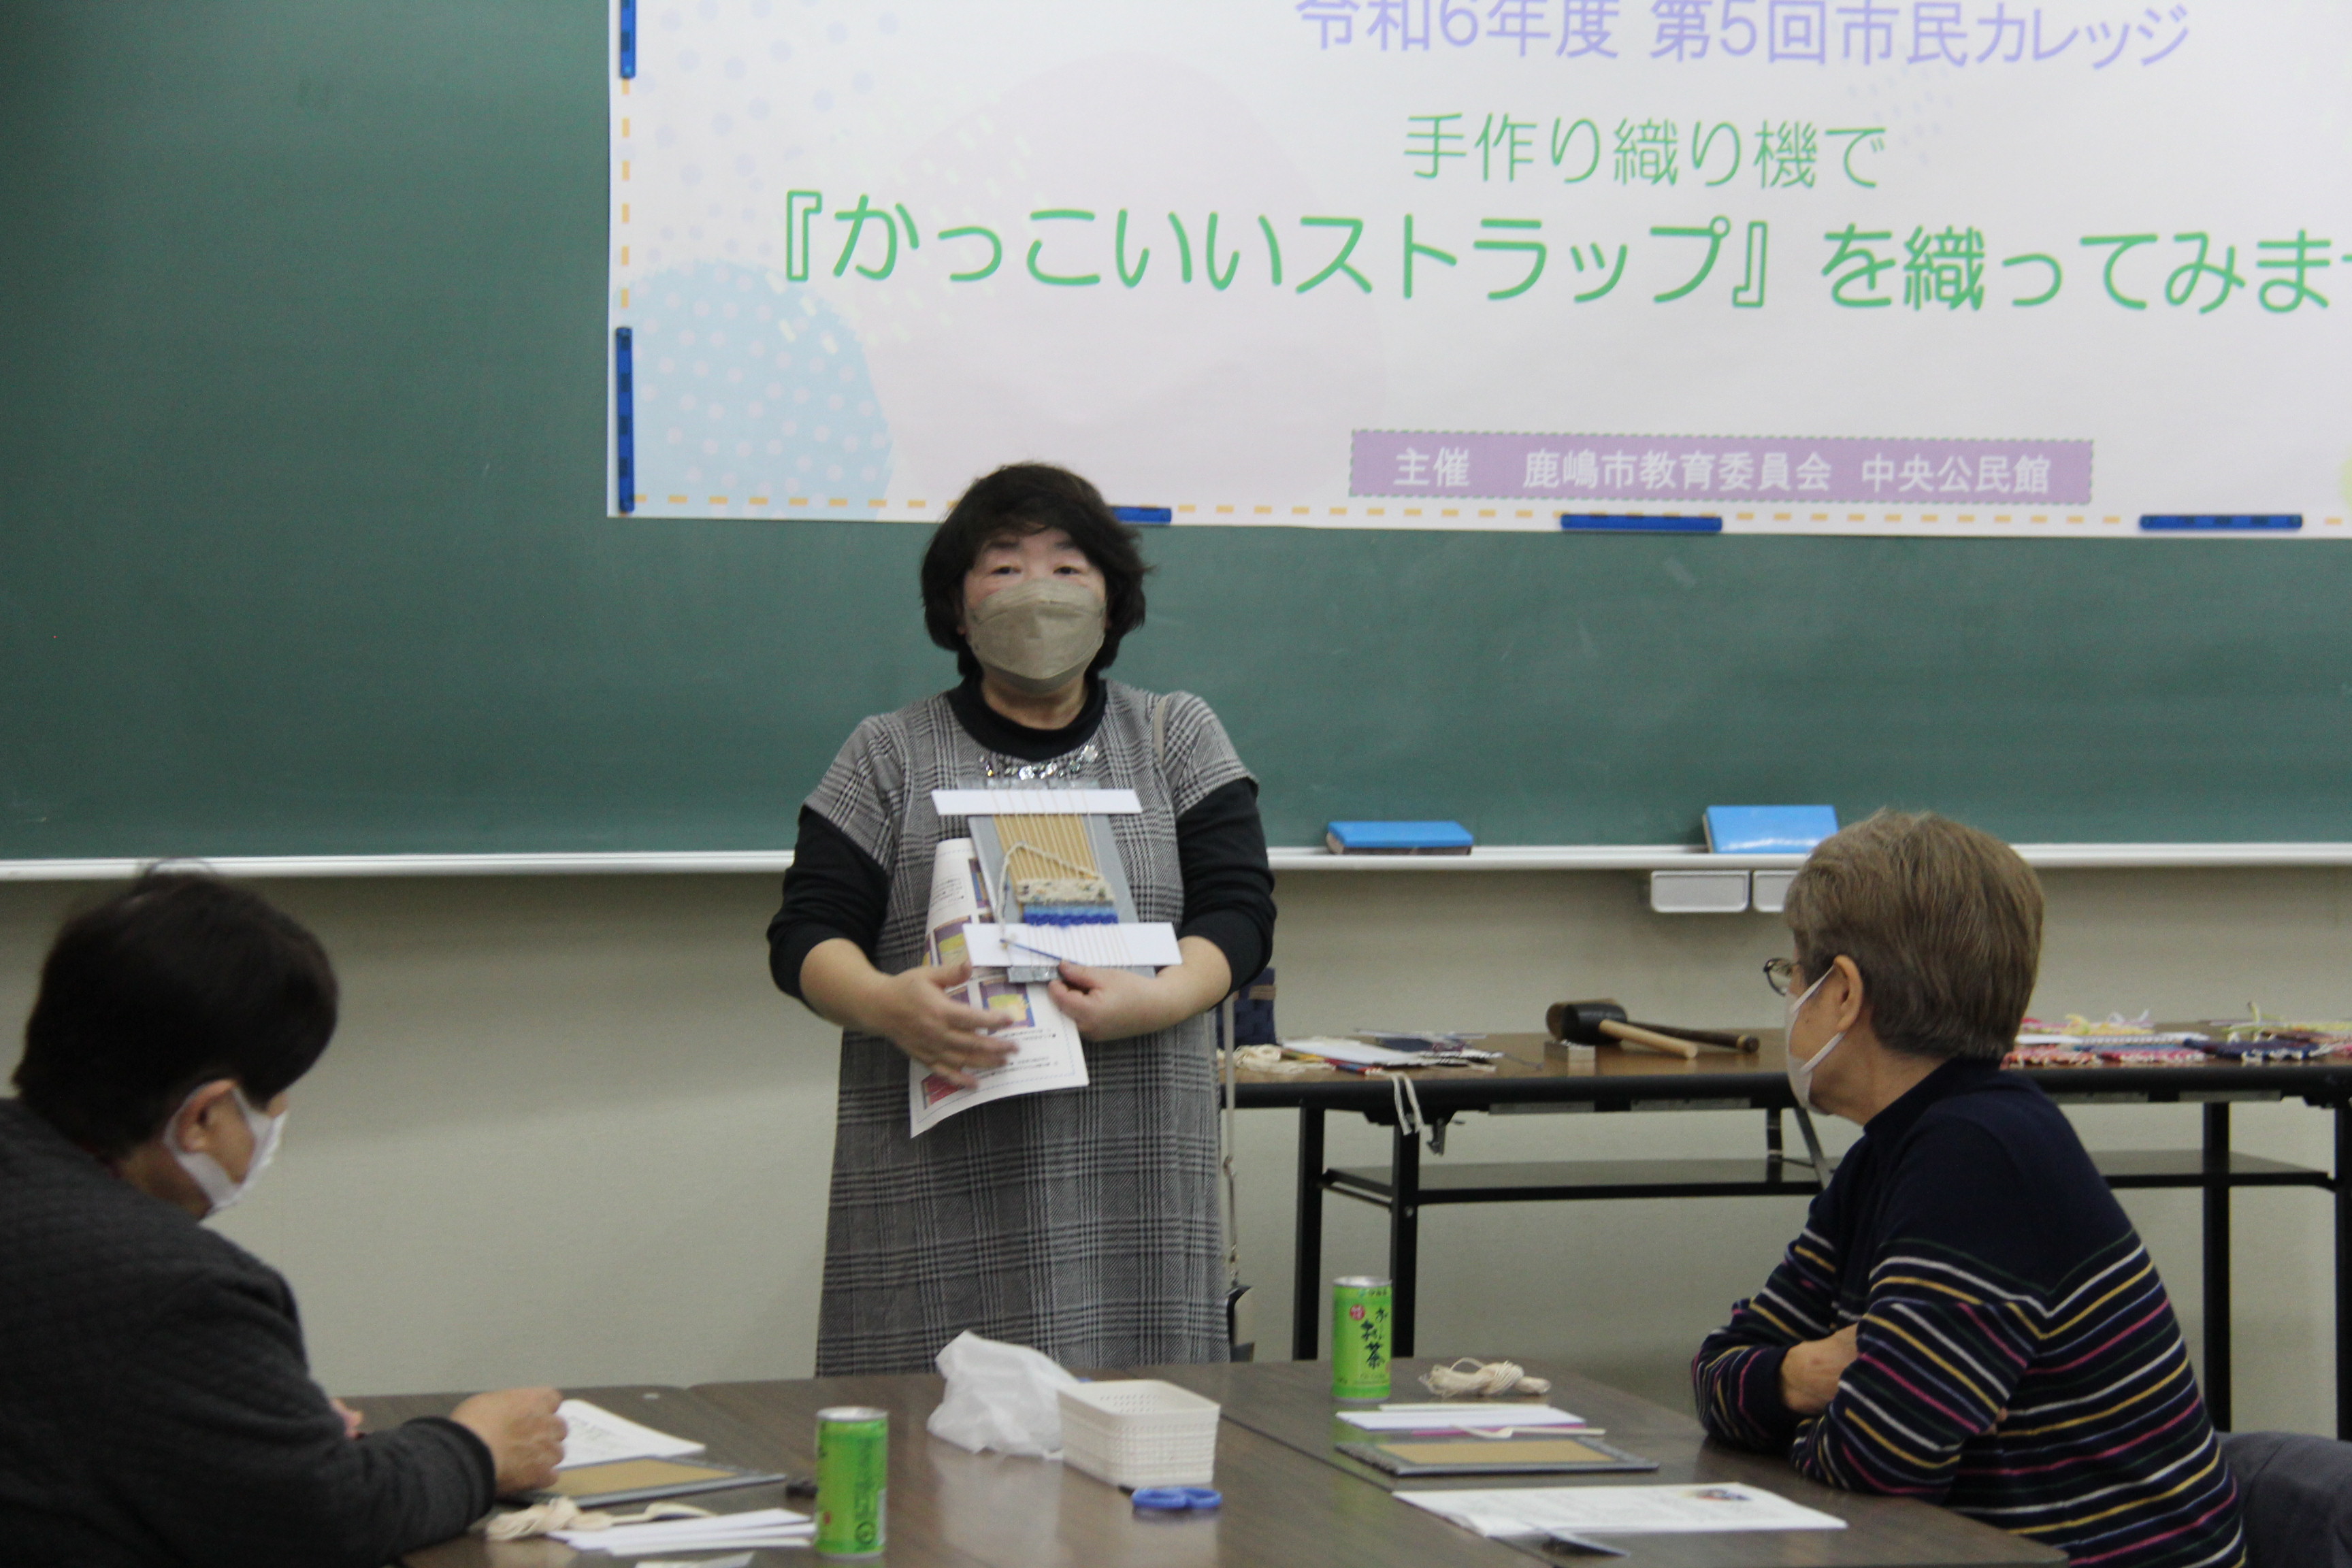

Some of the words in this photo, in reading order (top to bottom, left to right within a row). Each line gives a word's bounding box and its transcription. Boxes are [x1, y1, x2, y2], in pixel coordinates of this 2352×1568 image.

[1296, 0, 1620, 59] 令和6年度
[1650, 0, 2190, 70] 第5回市民カレッジ
[1403, 112, 1889, 191] 手作り織り機で
[786, 190, 2352, 315] 『かっこいいストラップ』を織ってみま
[1393, 446, 1471, 488] 主催
[1522, 448, 1833, 491] 鹿嶋市教育委員会
[1862, 453, 2053, 495] 中央公民館
